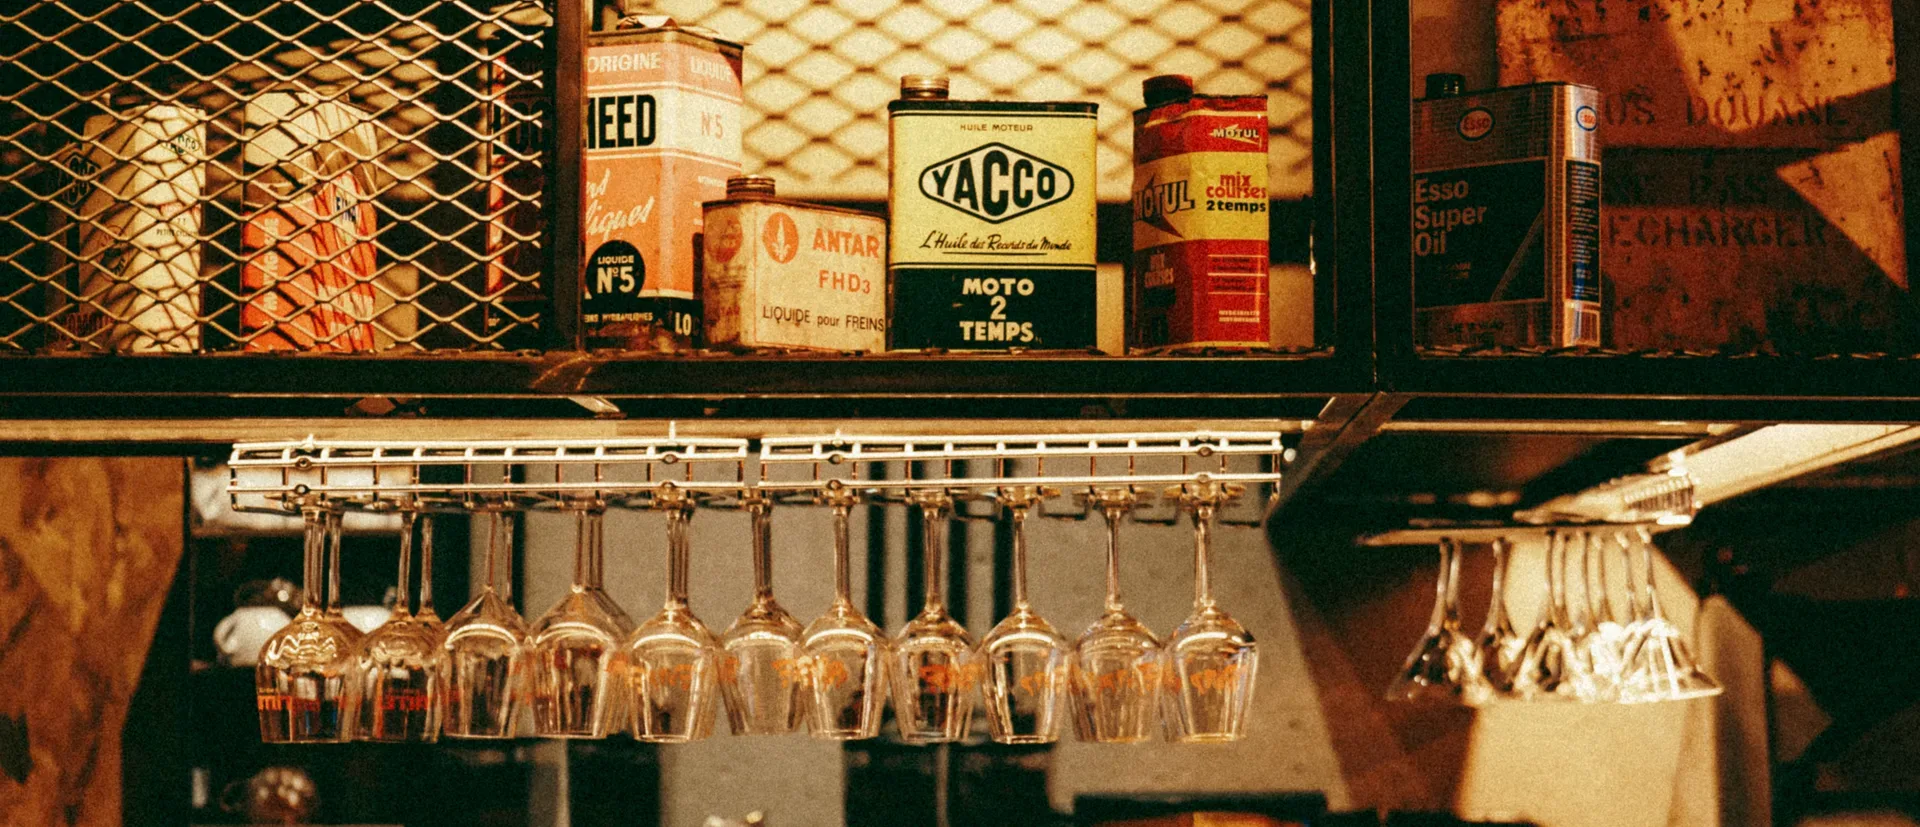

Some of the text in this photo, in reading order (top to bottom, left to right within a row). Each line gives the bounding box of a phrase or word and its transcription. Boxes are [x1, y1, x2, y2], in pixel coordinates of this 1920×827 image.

[587, 52, 661, 73] ORIGINE
[960, 124, 1033, 132] HUILE MOTEUR
[1212, 128, 1259, 138] MOTUL
[932, 150, 1056, 216] YACCO
[1220, 172, 1251, 187] mix
[1206, 184, 1266, 199] courses
[1414, 179, 1469, 202] Esso
[1414, 206, 1487, 232] Super
[813, 228, 881, 258] ANTAR
[970, 237, 986, 250] des
[987, 234, 1025, 250] Records
[1026, 237, 1039, 250] du
[1414, 231, 1446, 256] Oil
[597, 255, 634, 265] LIQUIDE
[962, 278, 1034, 296] MOTO
[990, 295, 1006, 320] 2
[763, 305, 811, 324] LIQUIDE
[817, 314, 839, 327] pour
[845, 314, 884, 332] FREINS
[959, 321, 1034, 342] TEMPS
